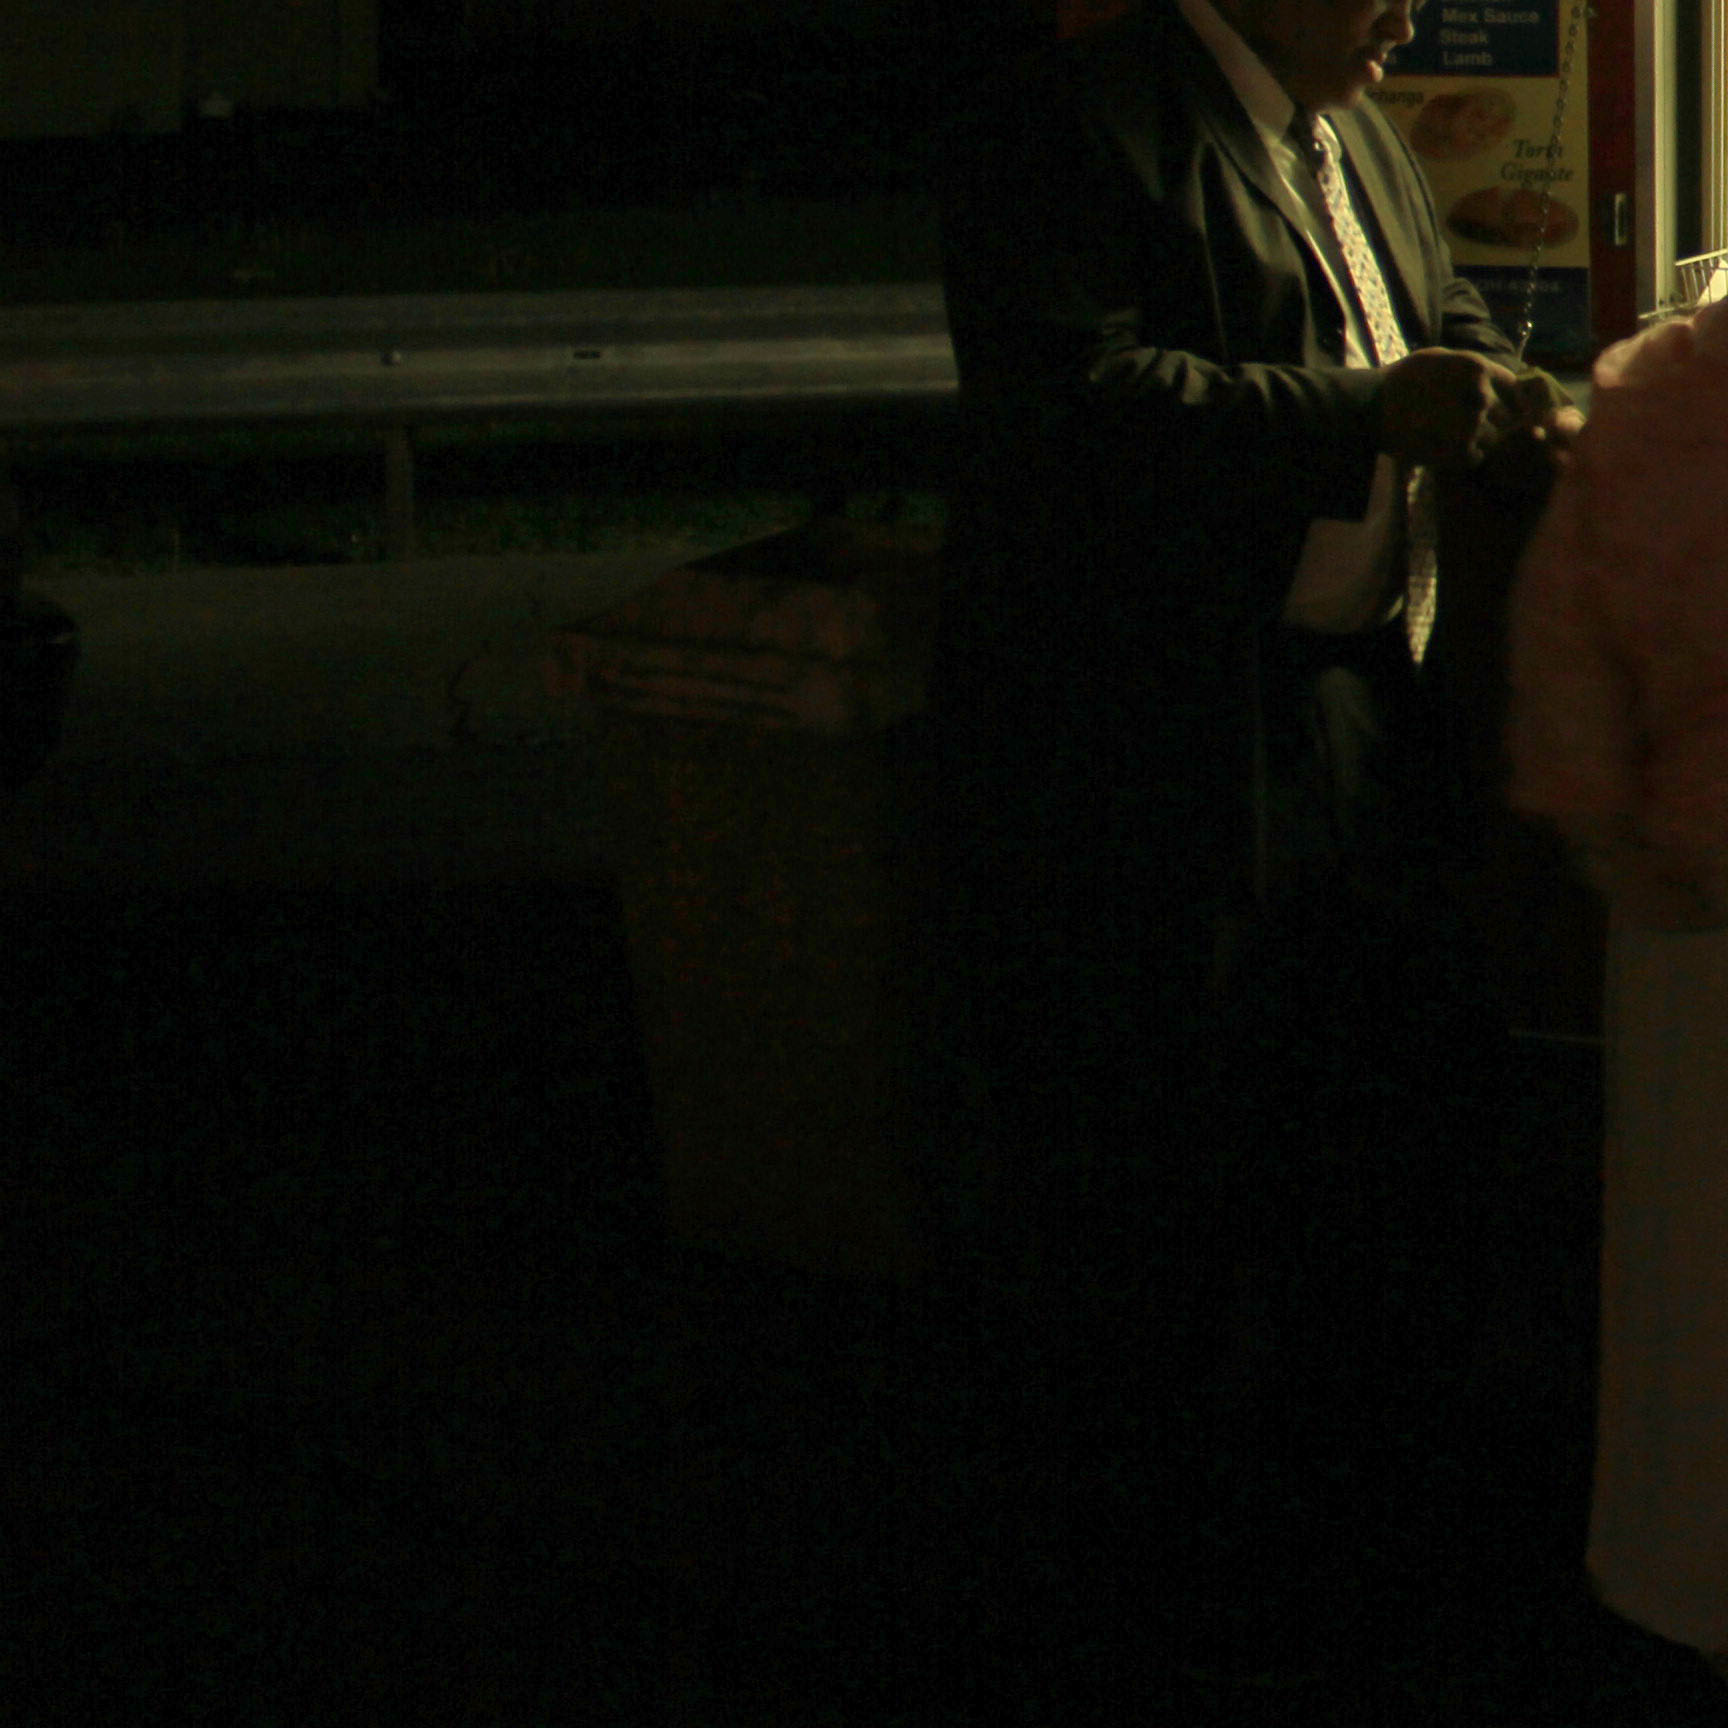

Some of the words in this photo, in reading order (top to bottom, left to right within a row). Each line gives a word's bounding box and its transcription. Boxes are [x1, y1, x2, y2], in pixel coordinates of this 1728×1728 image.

[1483, 7, 1541, 24] Sauce
[1438, 28, 1490, 46] Steak
[1442, 49, 1494, 67] Lamb
